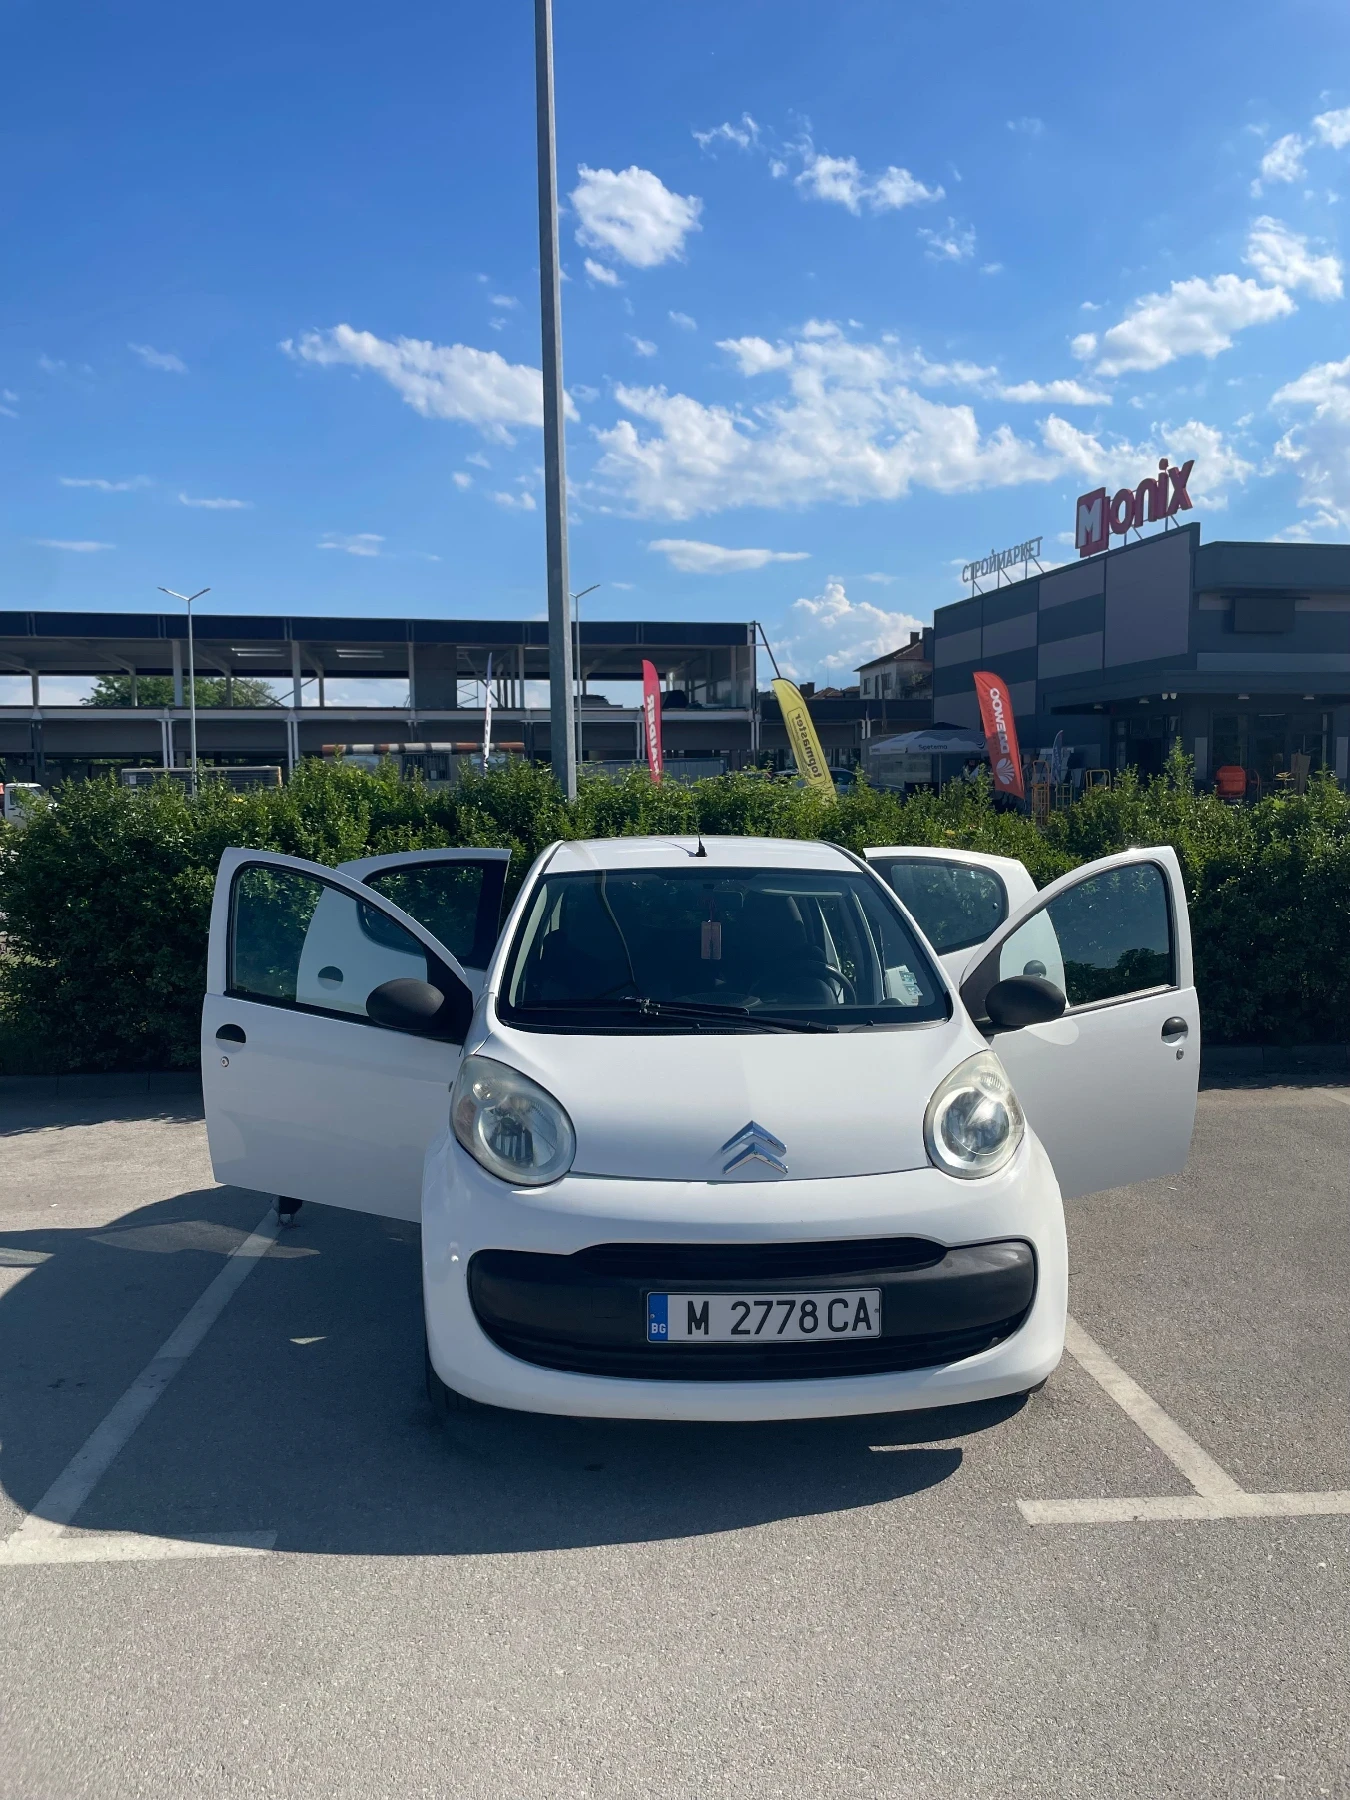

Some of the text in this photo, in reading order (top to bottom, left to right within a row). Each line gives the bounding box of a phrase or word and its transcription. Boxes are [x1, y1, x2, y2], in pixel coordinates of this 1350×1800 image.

[962, 536, 1043, 583] СТРОЙМАРКЕТ
[651, 1323, 666, 1334] BG
[687, 1297, 872, 1335] M 2778 CA
